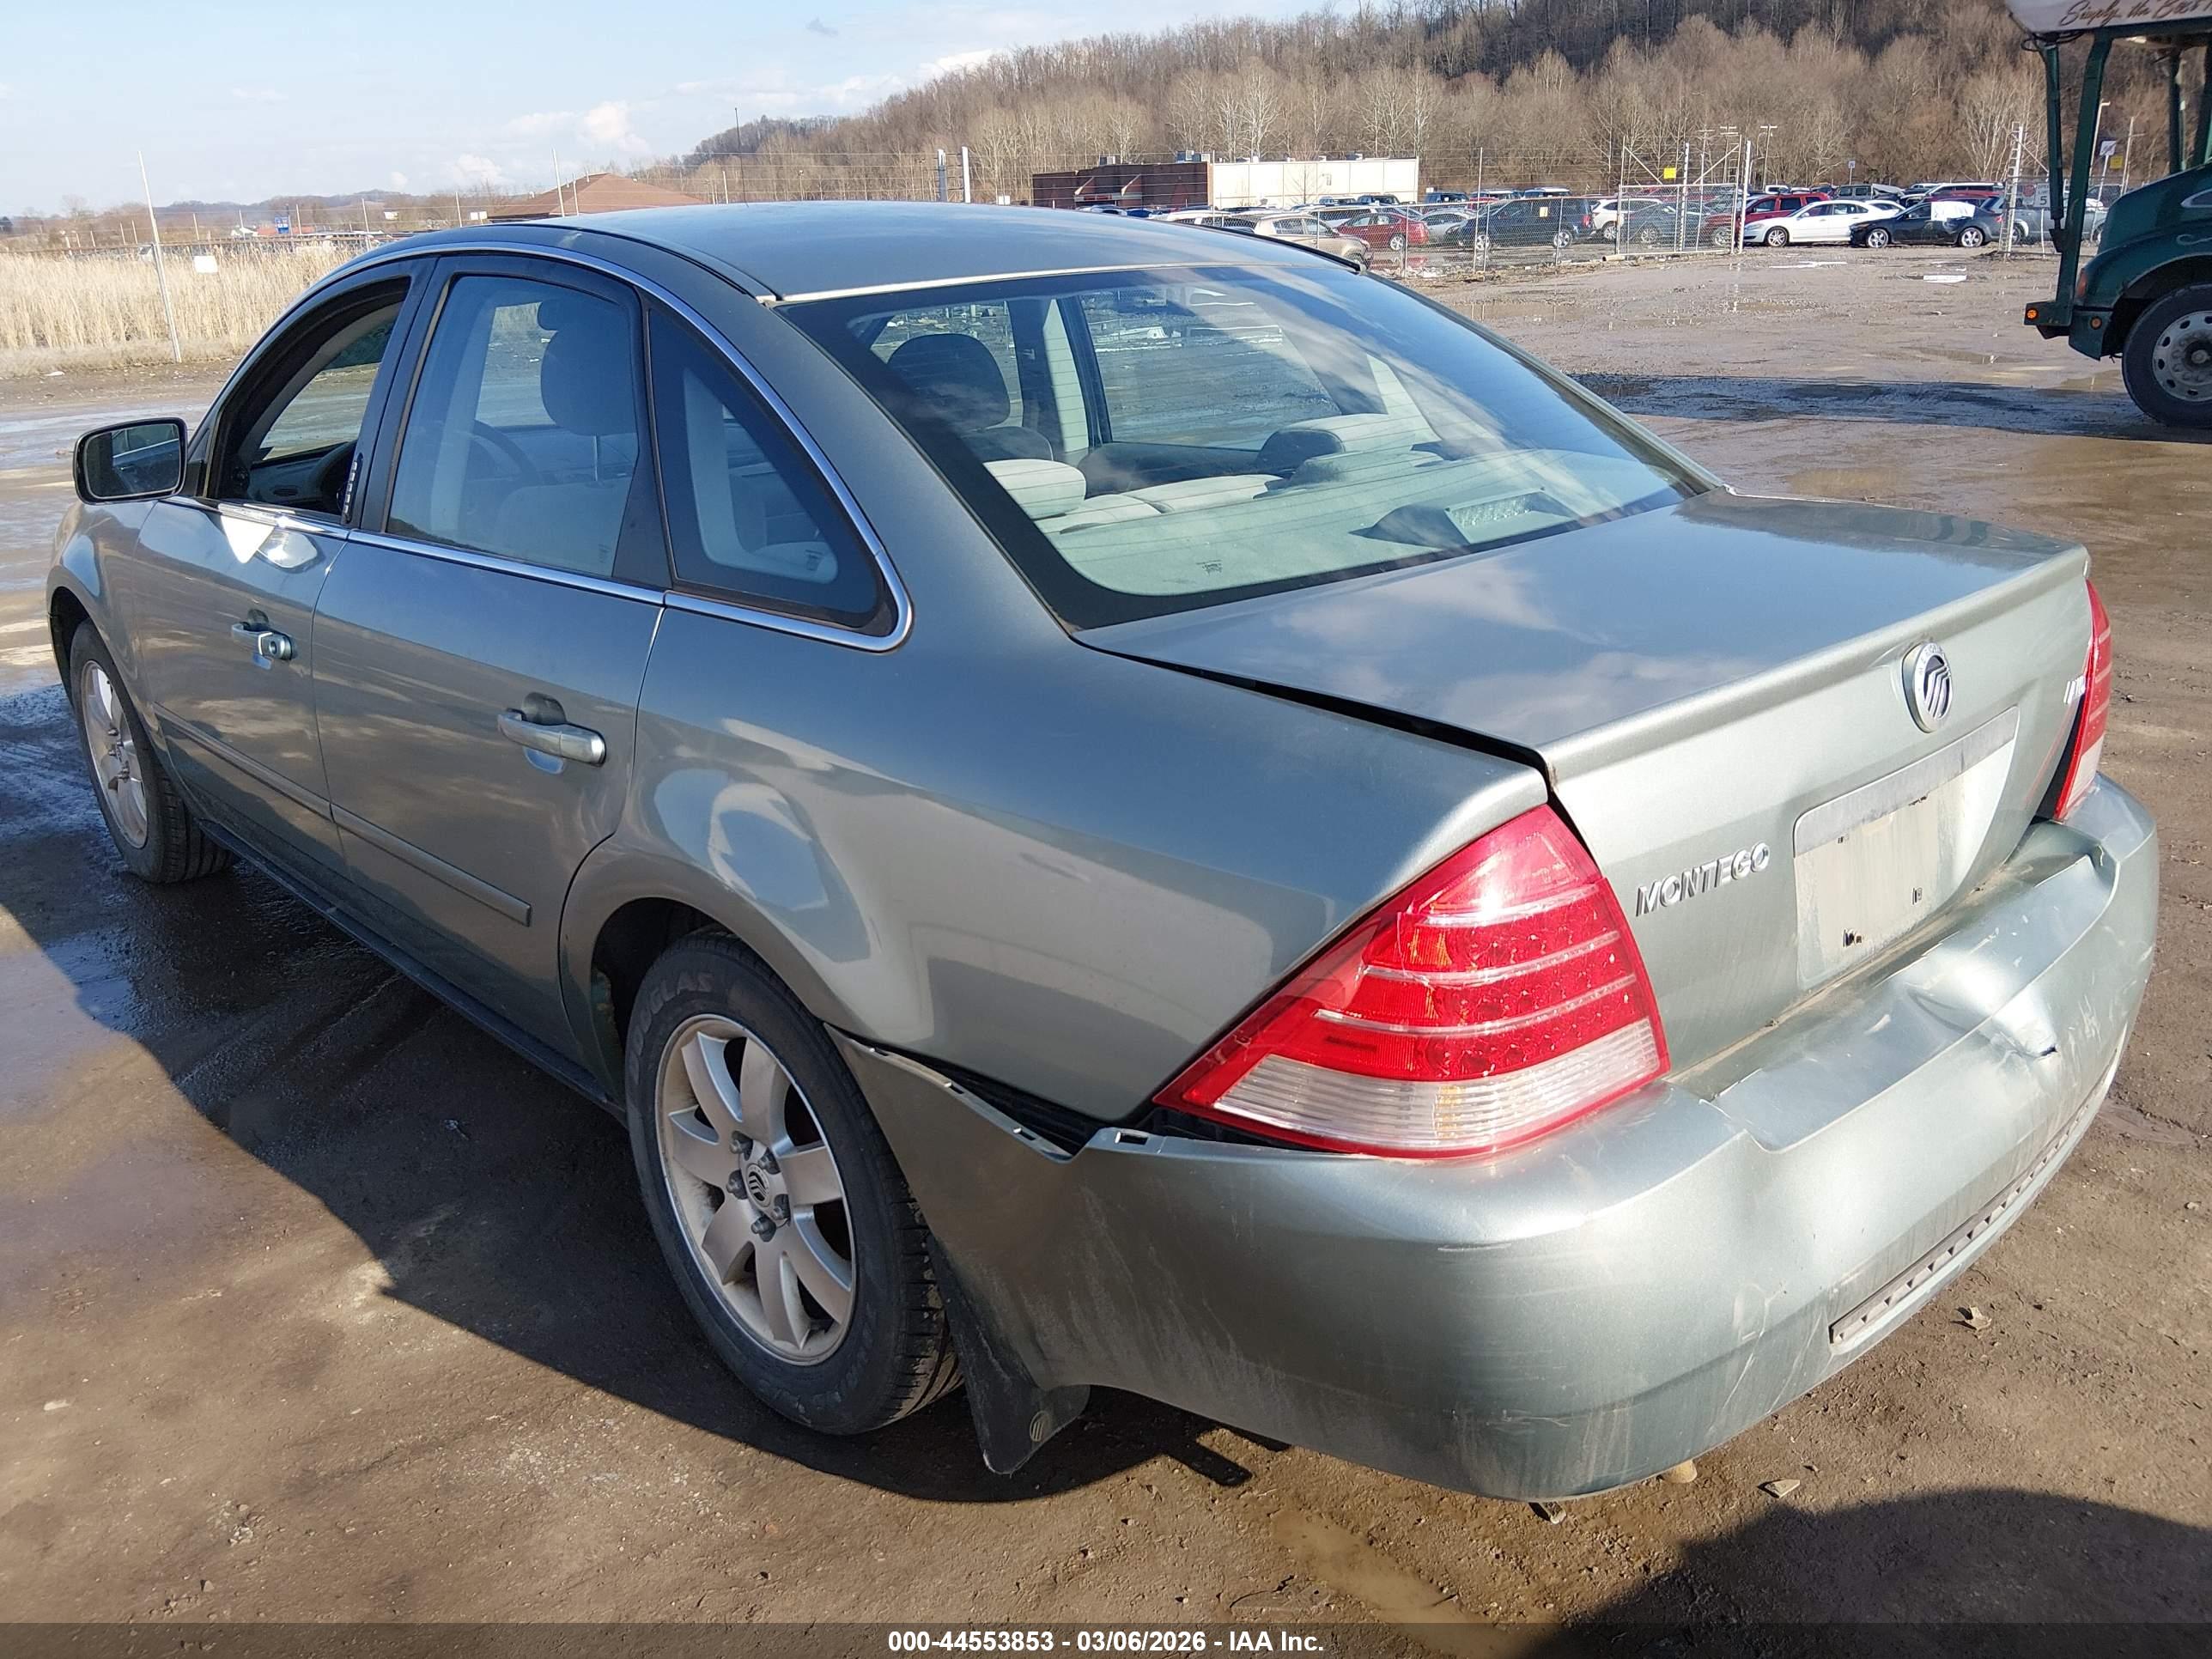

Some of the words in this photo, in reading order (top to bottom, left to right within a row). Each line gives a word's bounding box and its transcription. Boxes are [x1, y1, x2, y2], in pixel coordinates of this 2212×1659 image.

[2059, 0, 2122, 27] Simply
[2127, 0, 2150, 19] the
[2039, 195, 2048, 206] 5
[1635, 841, 1771, 918] MONTEGO
[628, 970, 714, 1087] DOUGLAS
